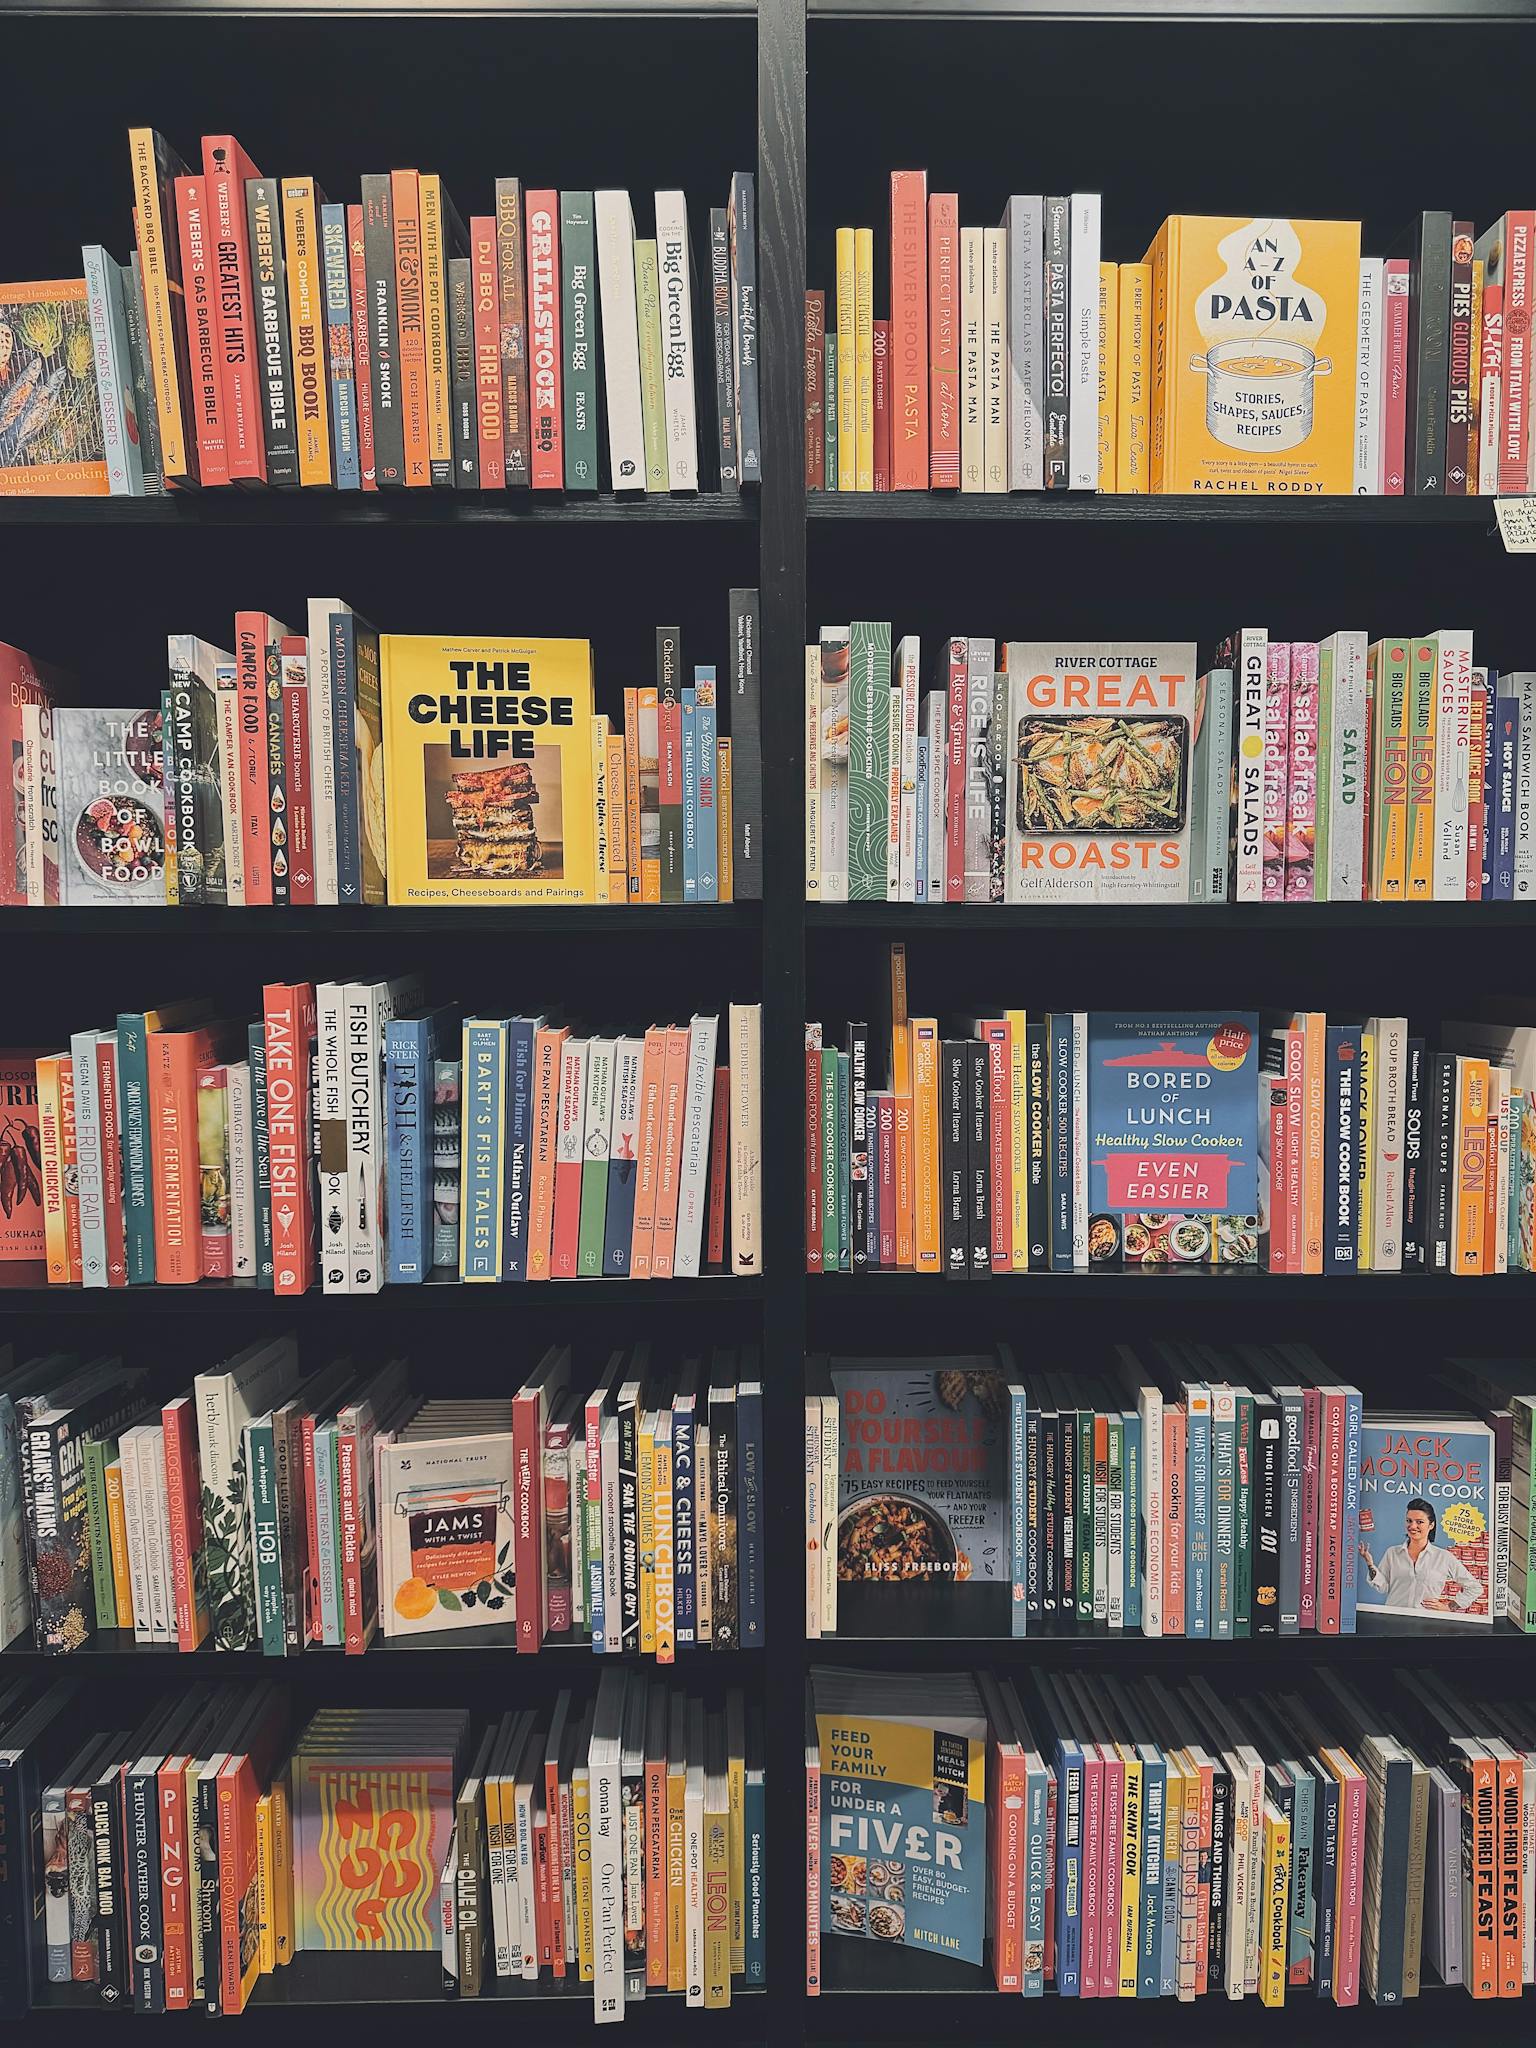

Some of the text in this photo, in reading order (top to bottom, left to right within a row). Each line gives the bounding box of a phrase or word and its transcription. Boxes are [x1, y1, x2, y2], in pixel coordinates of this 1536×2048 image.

[1251, 238, 1278, 253] AN
[217, 182, 245, 364] WEBER'S GREATEST HITS
[324, 224, 348, 309] SKEWERED
[477, 242, 493, 312] DJ BBQ
[1513, 226, 1527, 308] PIZZAEXPRESS
[1251, 275, 1276, 290] OF
[255, 205, 287, 429] WEBER'S BARBECUE BIBLE
[376, 280, 388, 347] FRANKLIN
[532, 211, 555, 409] GRILLSTOCK
[572, 265, 587, 370] Big Green Egg
[1210, 294, 1313, 322] PASTA
[1051, 264, 1065, 397] PASTA PERFECTO!
[1081, 308, 1091, 384] Simple Pasta
[379, 362, 391, 408] SMOKE
[991, 322, 1000, 424] THE PASTA MAN
[480, 344, 500, 440] FIRE FOOD
[1235, 392, 1285, 405] STORIES,
[576, 392, 586, 430] FEASTS
[1213, 403, 1259, 421] SHAPES,
[1237, 424, 1282, 436] RECIPES
[1194, 480, 1324, 492] RACHEL RODDY
[450, 662, 530, 691] THE
[1055, 657, 1157, 668] RIVER COTTAGE
[1026, 675, 1185, 707] GREAT
[408, 694, 573, 726] CHEESE
[106, 723, 148, 738] THE
[269, 712, 283, 776] CANAPÉS
[450, 729, 535, 758] LIFE
[93, 751, 164, 766] LITTLE
[1243, 656, 1261, 856] GREAT SALADS
[1342, 729, 1357, 805] SALAD
[1411, 736, 1434, 805] LEON
[175, 692, 195, 851] CAMP COOKBOOK
[1502, 741, 1512, 812] HOT SAUCE
[99, 780, 161, 795] BOOK
[117, 808, 146, 824] OF
[100, 838, 164, 852] BOWL
[1020, 842, 1181, 869] ROASTS
[102, 866, 164, 881] FOOD
[1020, 877, 1093, 889] Gelf Alderson
[408, 888, 584, 898] Recipes, Cheeseboards and Pairings
[392, 1041, 417, 1049] RICK
[1219, 1038, 1244, 1050] price
[1223, 1028, 1245, 1040] Half
[389, 1050, 420, 1058] STEIN
[349, 1005, 370, 1154] FISH BUTCHERY
[1127, 1072, 1212, 1089] BORED
[267, 1009, 296, 1198] TAKE ONE FISH
[1058, 1038, 1068, 1177] SLOW COOKER 500 RECIPES
[1161, 1094, 1179, 1102] OF
[61, 1072, 75, 1158] FALAFEL
[1128, 1108, 1211, 1124] LUNCH
[1096, 1133, 1243, 1148] Healthy Slow Cooker
[1408, 1109, 1421, 1160] SOUPS
[476, 1053, 491, 1249] BART'S FISH TALES
[1138, 1162, 1198, 1177] EVEN
[511, 1143, 522, 1239] Nathan Outlaw
[1126, 1184, 1209, 1199] EASIER
[676, 1424, 690, 1469] MAC
[1381, 1433, 1451, 1457] JACK
[861, 1480, 925, 1491] EASY RECIPES
[1217, 1431, 1232, 1555] WHAT'S FOR DINNER?
[1384, 1479, 1422, 1495] CAN
[1428, 1482, 1485, 1500] COOK
[342, 1444, 355, 1563] Preserves and Pickles
[1459, 1509, 1471, 1517] 75
[423, 1514, 483, 1533] JAMS
[1444, 1519, 1480, 1533] CUPBOARD
[1448, 1528, 1475, 1537] RECIPES
[1453, 1515, 1474, 1524] STORE
[258, 1522, 275, 1564] HOB
[425, 1535, 448, 1543] WITH
[458, 1531, 483, 1540] TWIST
[676, 1498, 691, 1575] CHEESE
[1261, 1526, 1278, 1554] 101
[655, 1491, 672, 1632] LUNCHBOX
[865, 1563, 968, 1572] FLISS FREEBORN
[832, 1729, 870, 1744] FEED
[832, 1745, 873, 1760] YOUR
[832, 1759, 887, 1776] FAMILY
[831, 1780, 862, 1794] FOR
[599, 1778, 611, 1837] donna hay
[831, 1795, 902, 1816] UNDER A
[577, 1812, 591, 1862] SOLO
[1324, 1803, 1336, 1866] TOFU TASTY
[134, 1791, 151, 1940] HUNTER GATHER COOK
[670, 1822, 683, 1887] CHICKEN
[1476, 1786, 1493, 1941] WOOD-FIRED FEAST
[751, 1833, 761, 1939] Seriously Good Pancakes
[912, 1866, 945, 1879] OVER 80
[222, 1850, 235, 1932] MICROWAVE
[706, 1872, 727, 1932] LEON
[912, 1883, 950, 1897] FRIENDLY
[912, 1891, 945, 1905] RECIPES
[202, 1879, 215, 1933] Shroom
[602, 1863, 616, 1975] One Pan Perfect
[913, 1929, 960, 1950] MITCH LANE
[1271, 1899, 1283, 1951] Cookbook
